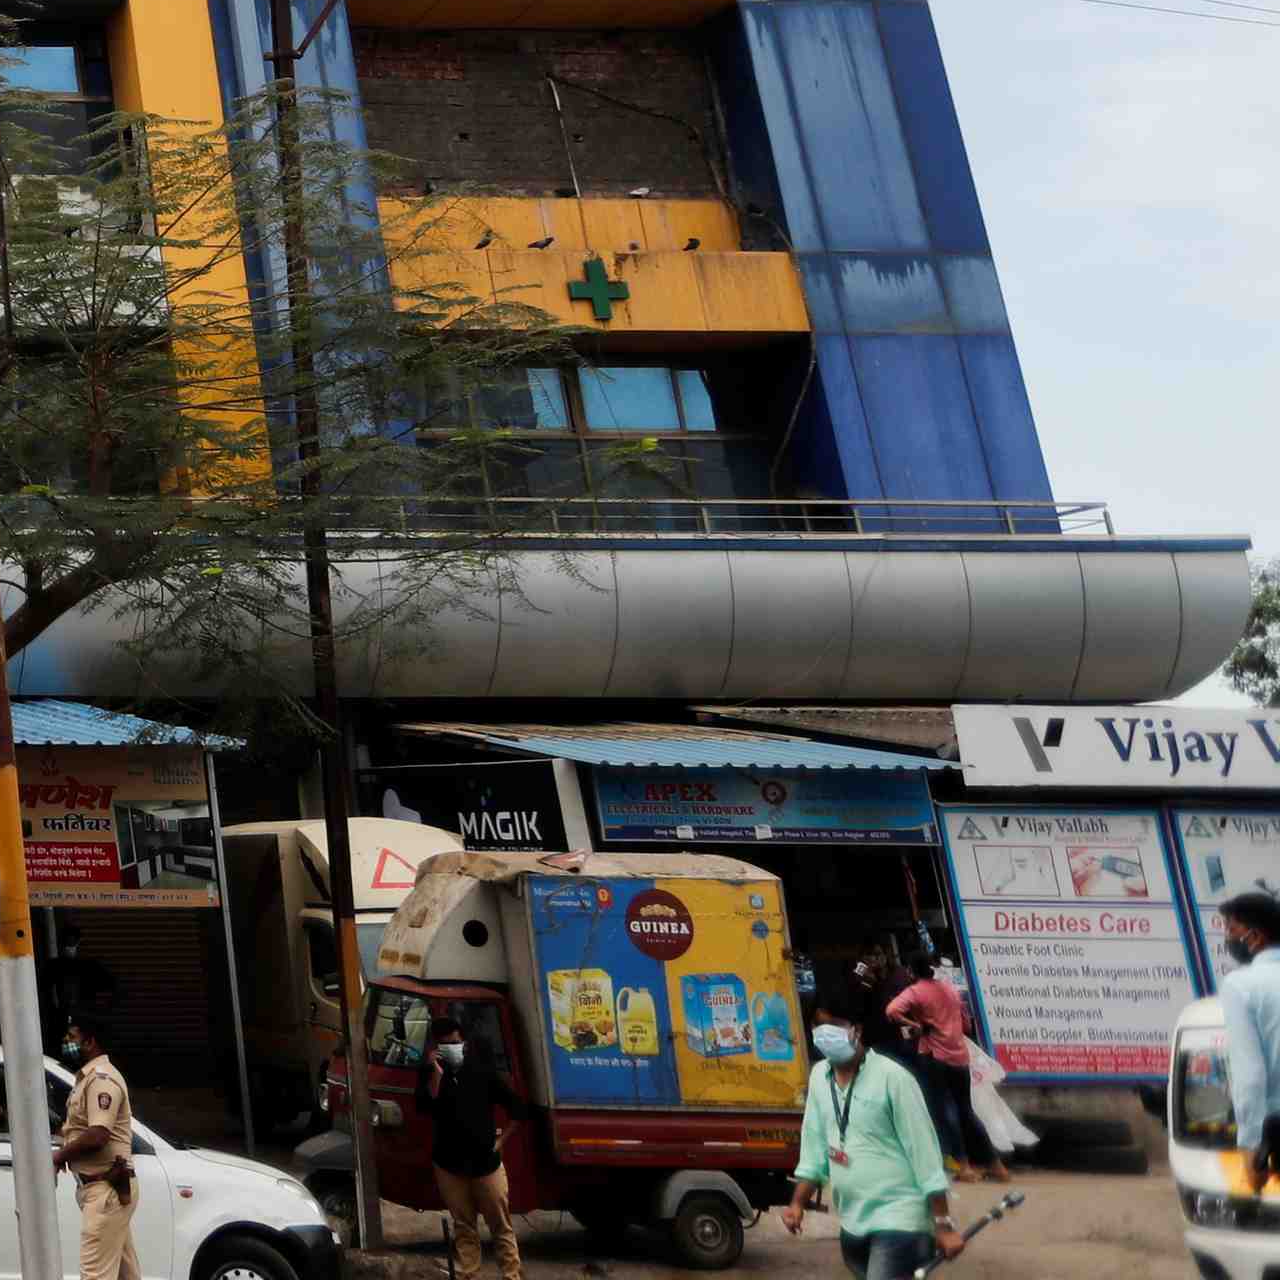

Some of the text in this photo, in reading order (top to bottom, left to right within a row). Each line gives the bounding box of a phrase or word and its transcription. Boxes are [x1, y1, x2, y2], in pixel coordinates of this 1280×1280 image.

[1095, 717, 1239, 777] Vijay
[644, 783, 718, 802] APEX
[691, 805, 755, 816] HARDWARE
[457, 811, 543, 841] MAGIK
[1016, 817, 1109, 835] Vijay Vallabh
[1232, 817, 1268, 838] Vijay
[629, 920, 690, 935] GUINEA
[993, 911, 1151, 934] Diabetes Care
[980, 943, 1085, 958] Diabetic Foot Clinic
[985, 963, 1030, 977] Juvenile
[1032, 965, 1080, 978] Diabetes
[1082, 966, 1150, 982] Management
[989, 985, 1171, 1003] Gestational Diabetes Management
[993, 1006, 1103, 1023] Wound Management
[998, 1027, 1039, 1041] Arterial
